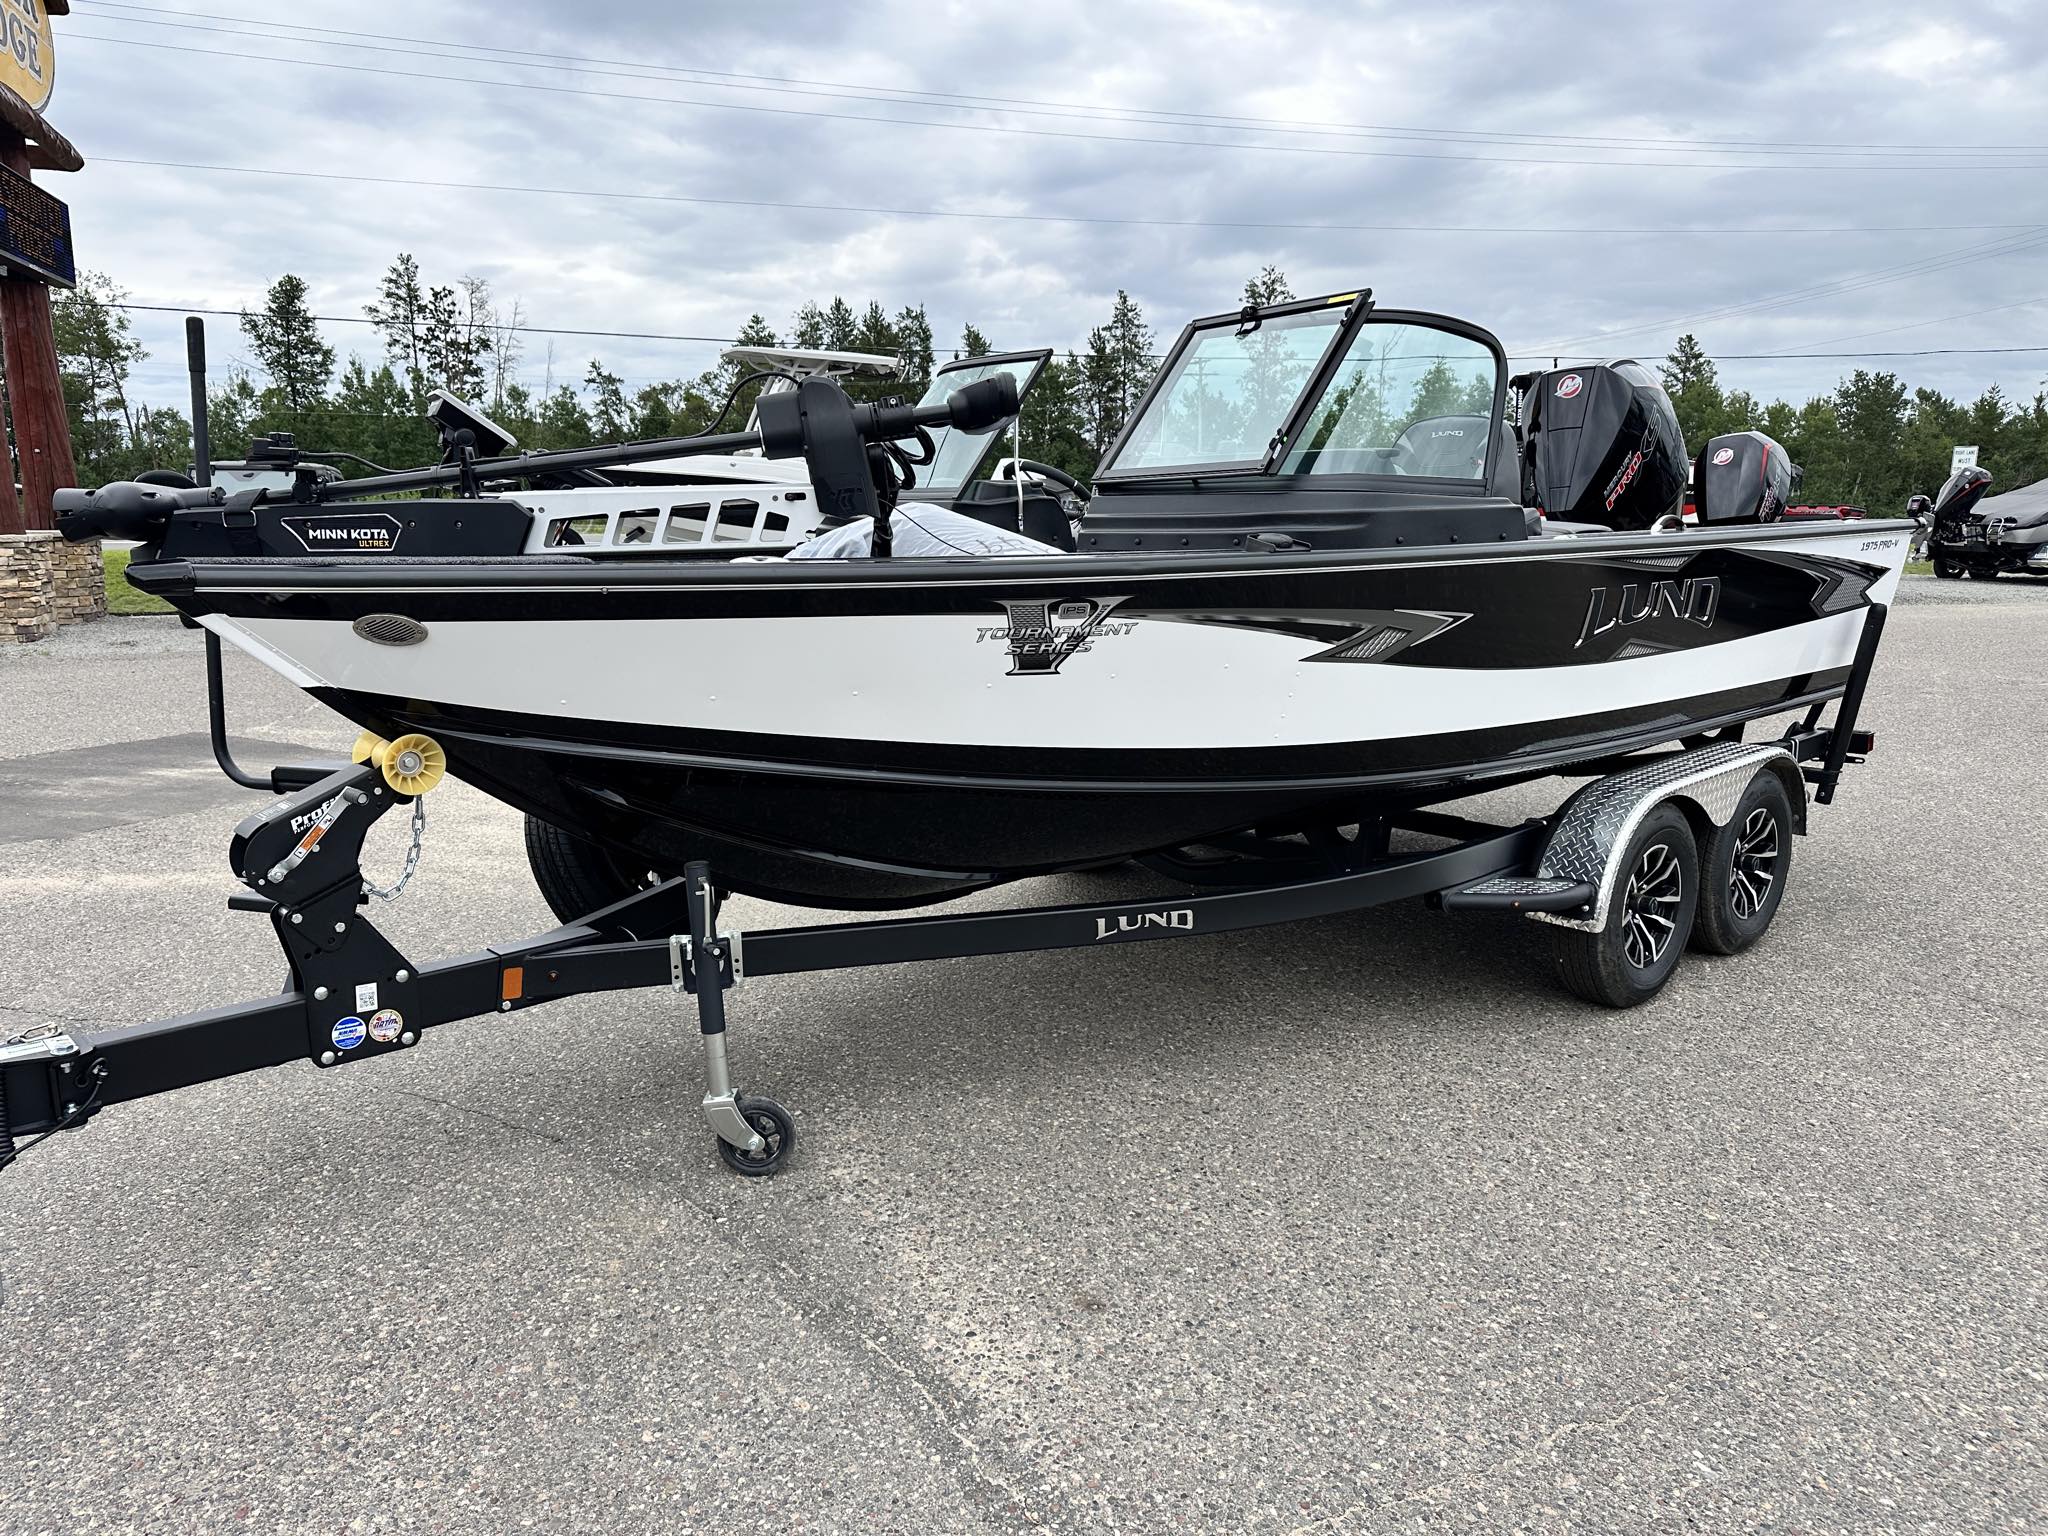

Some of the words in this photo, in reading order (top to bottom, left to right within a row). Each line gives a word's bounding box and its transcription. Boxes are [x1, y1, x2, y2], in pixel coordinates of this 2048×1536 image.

[1431, 430, 1464, 438] LUND
[1604, 450, 1633, 498] MERCURY
[1606, 450, 1643, 511] PRO
[308, 528, 348, 540] MINN
[350, 528, 390, 540] KOTA
[1860, 541, 1879, 551] 1975
[1878, 539, 1900, 551] PRO-V
[1062, 605, 1087, 616] IPS
[1574, 575, 1721, 649] LUND
[976, 622, 1139, 643] TOURNAMENT
[1004, 640, 1095, 655] SERIES
[1095, 909, 1194, 940] LUND
